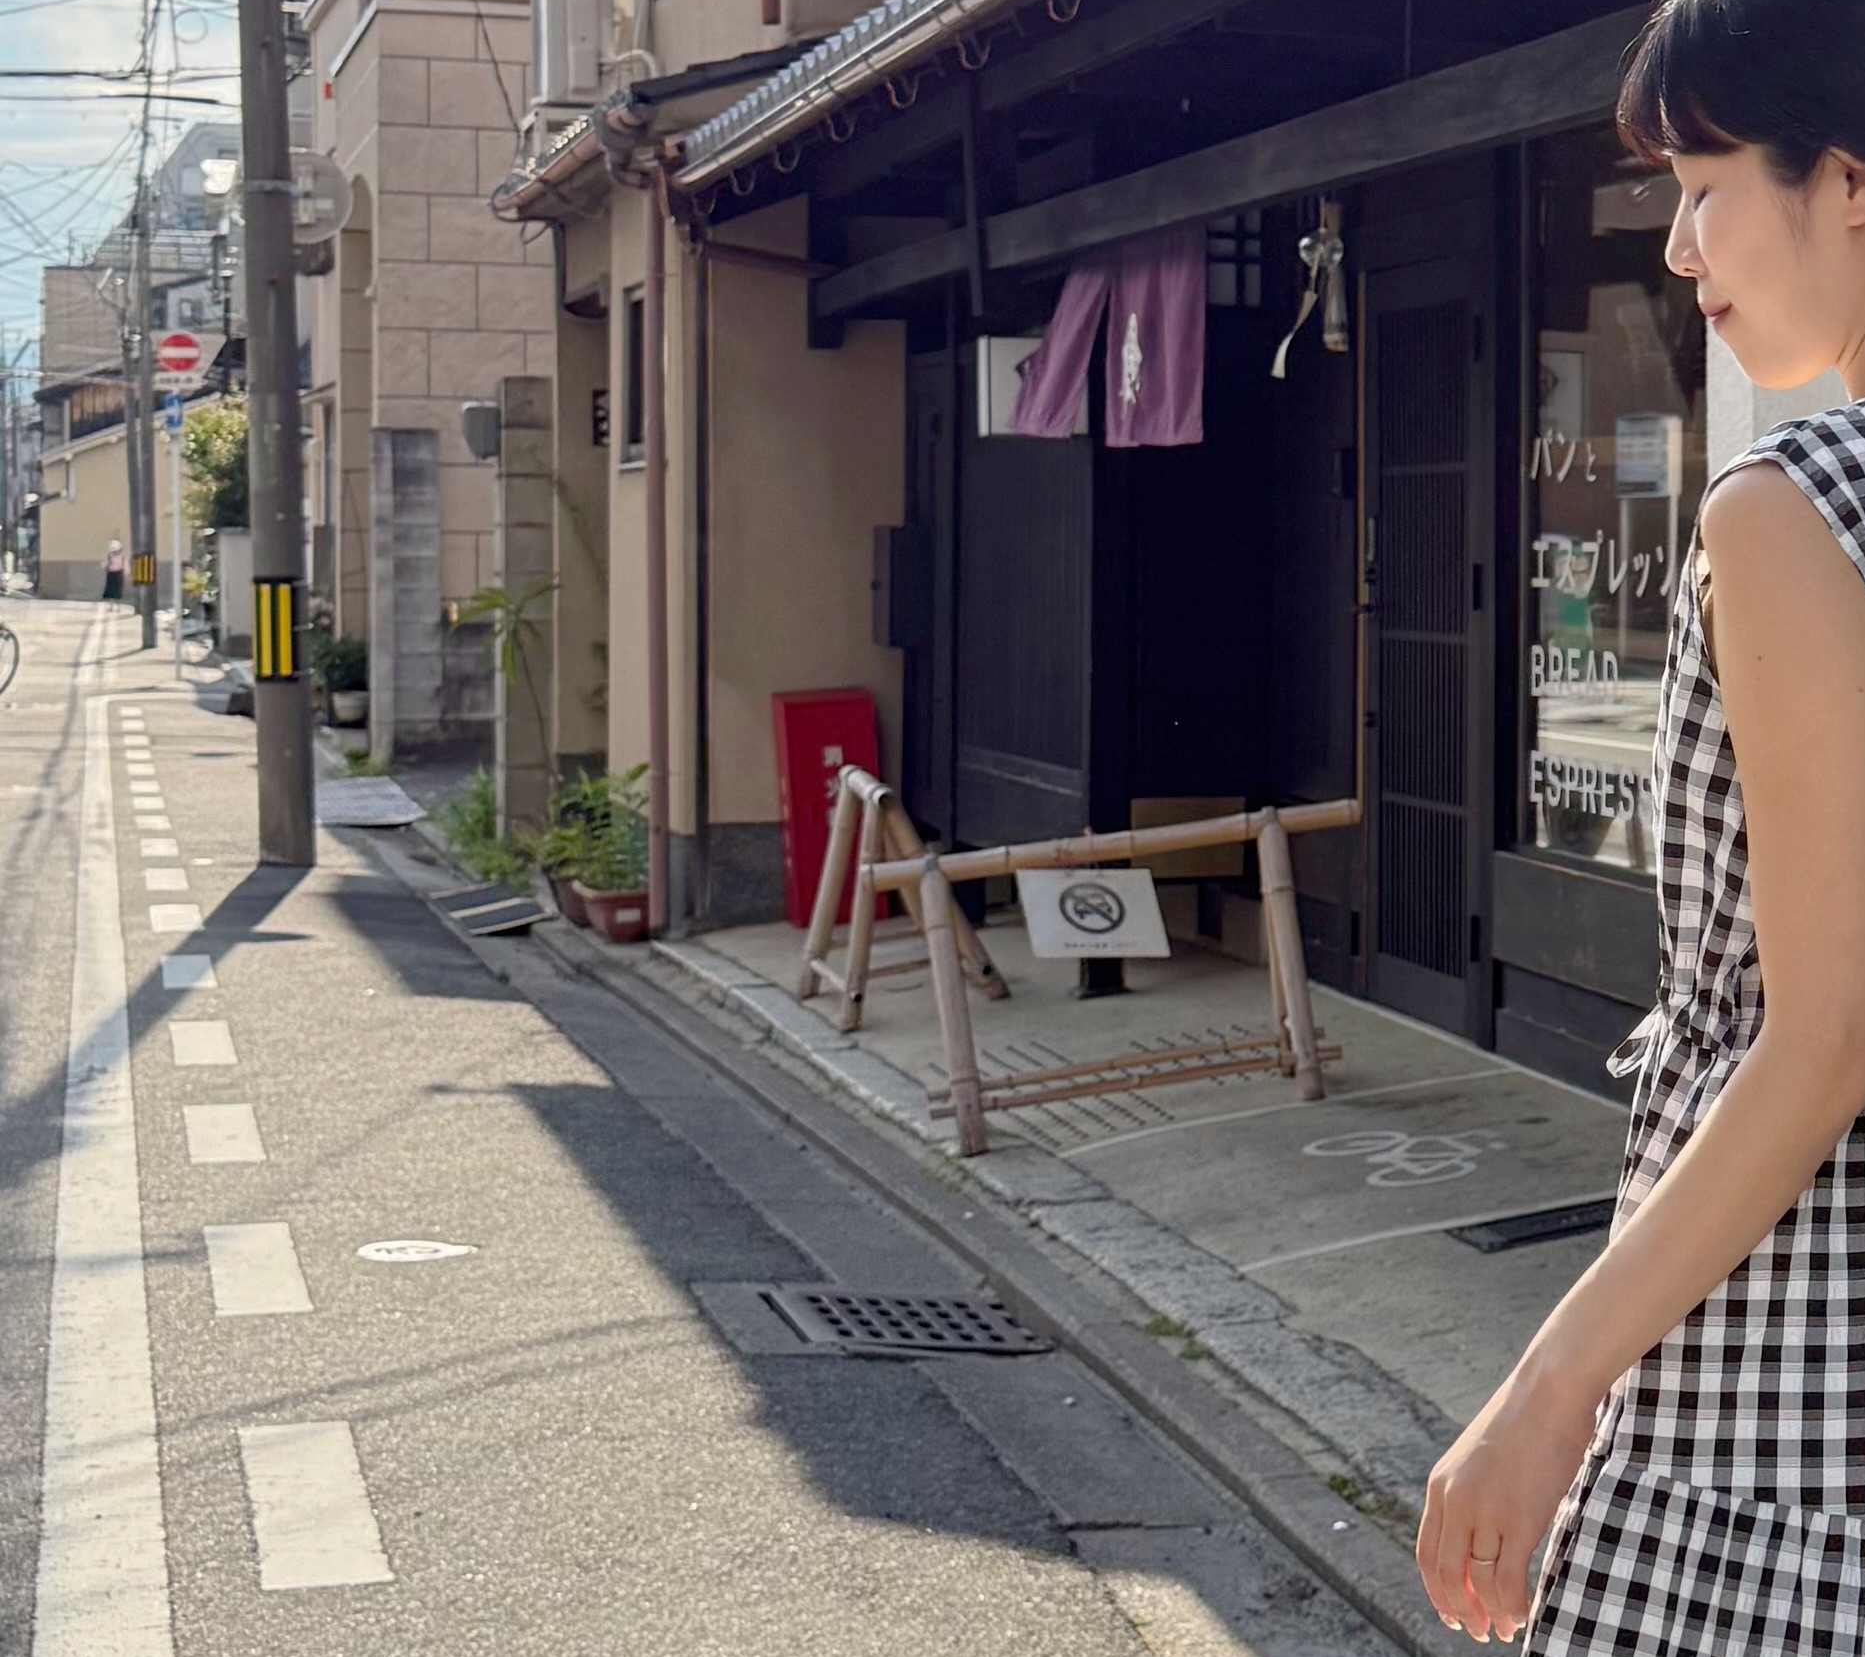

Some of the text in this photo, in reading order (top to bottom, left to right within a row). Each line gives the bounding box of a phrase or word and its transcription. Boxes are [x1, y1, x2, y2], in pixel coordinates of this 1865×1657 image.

[1530, 427, 1597, 483] パンと
[1530, 644, 1619, 700] BREAD
